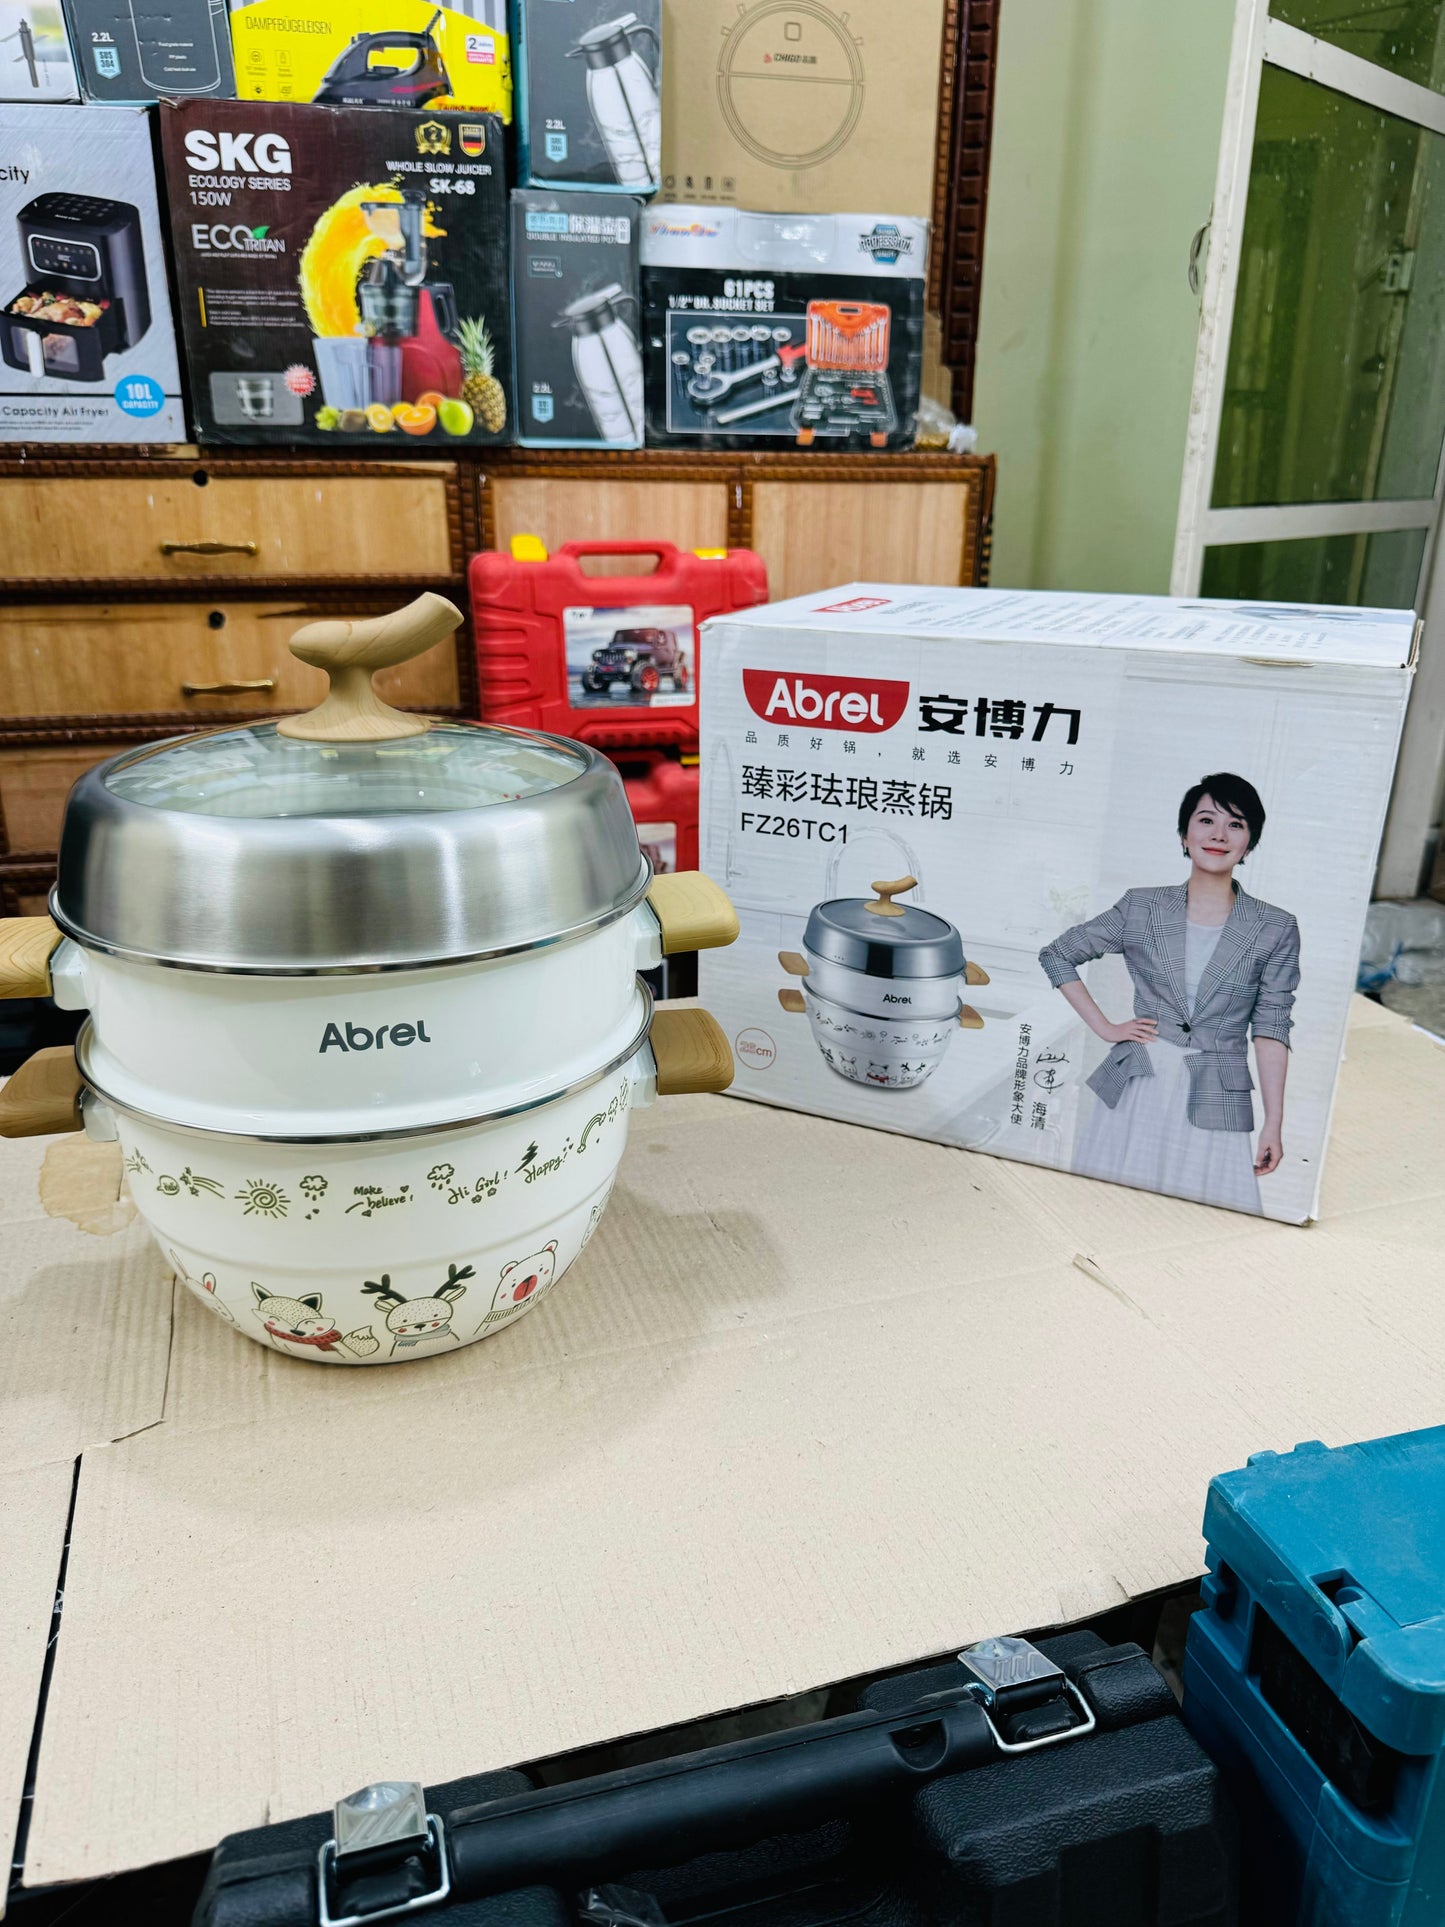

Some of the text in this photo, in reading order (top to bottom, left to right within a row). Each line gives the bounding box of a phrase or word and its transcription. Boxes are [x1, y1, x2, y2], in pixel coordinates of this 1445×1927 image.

[91, 32, 114, 42] 2.2L
[468, 37, 477, 50] 2
[546, 119, 567, 130] 2.2L
[184, 130, 293, 174] SKG
[385, 161, 492, 175] WHOLE SLOW JUICER
[188, 175, 292, 191] ECOLOGY SERIES
[429, 178, 476, 195] SK-68
[189, 191, 232, 206] 150W
[243, 237, 286, 253] TRITAN
[723, 278, 775, 299] 61PCS
[754, 299, 775, 312] SET
[126, 383, 152, 400] 10L
[3, 406, 109, 417] Capacity Air Fryer
[122, 400, 158, 410] CAPACITY
[765, 678, 884, 726] Abrel
[918, 694, 1082, 745] 安博力
[742, 765, 953, 820] 臻彩珐琅蒸锅
[741, 812, 848, 844] FZ26TC1
[882, 993, 912, 1005] Abrel
[319, 1020, 431, 1053] Abrel
[1031, 1101, 1047, 1130] 海清
[354, 1185, 383, 1196] Make
